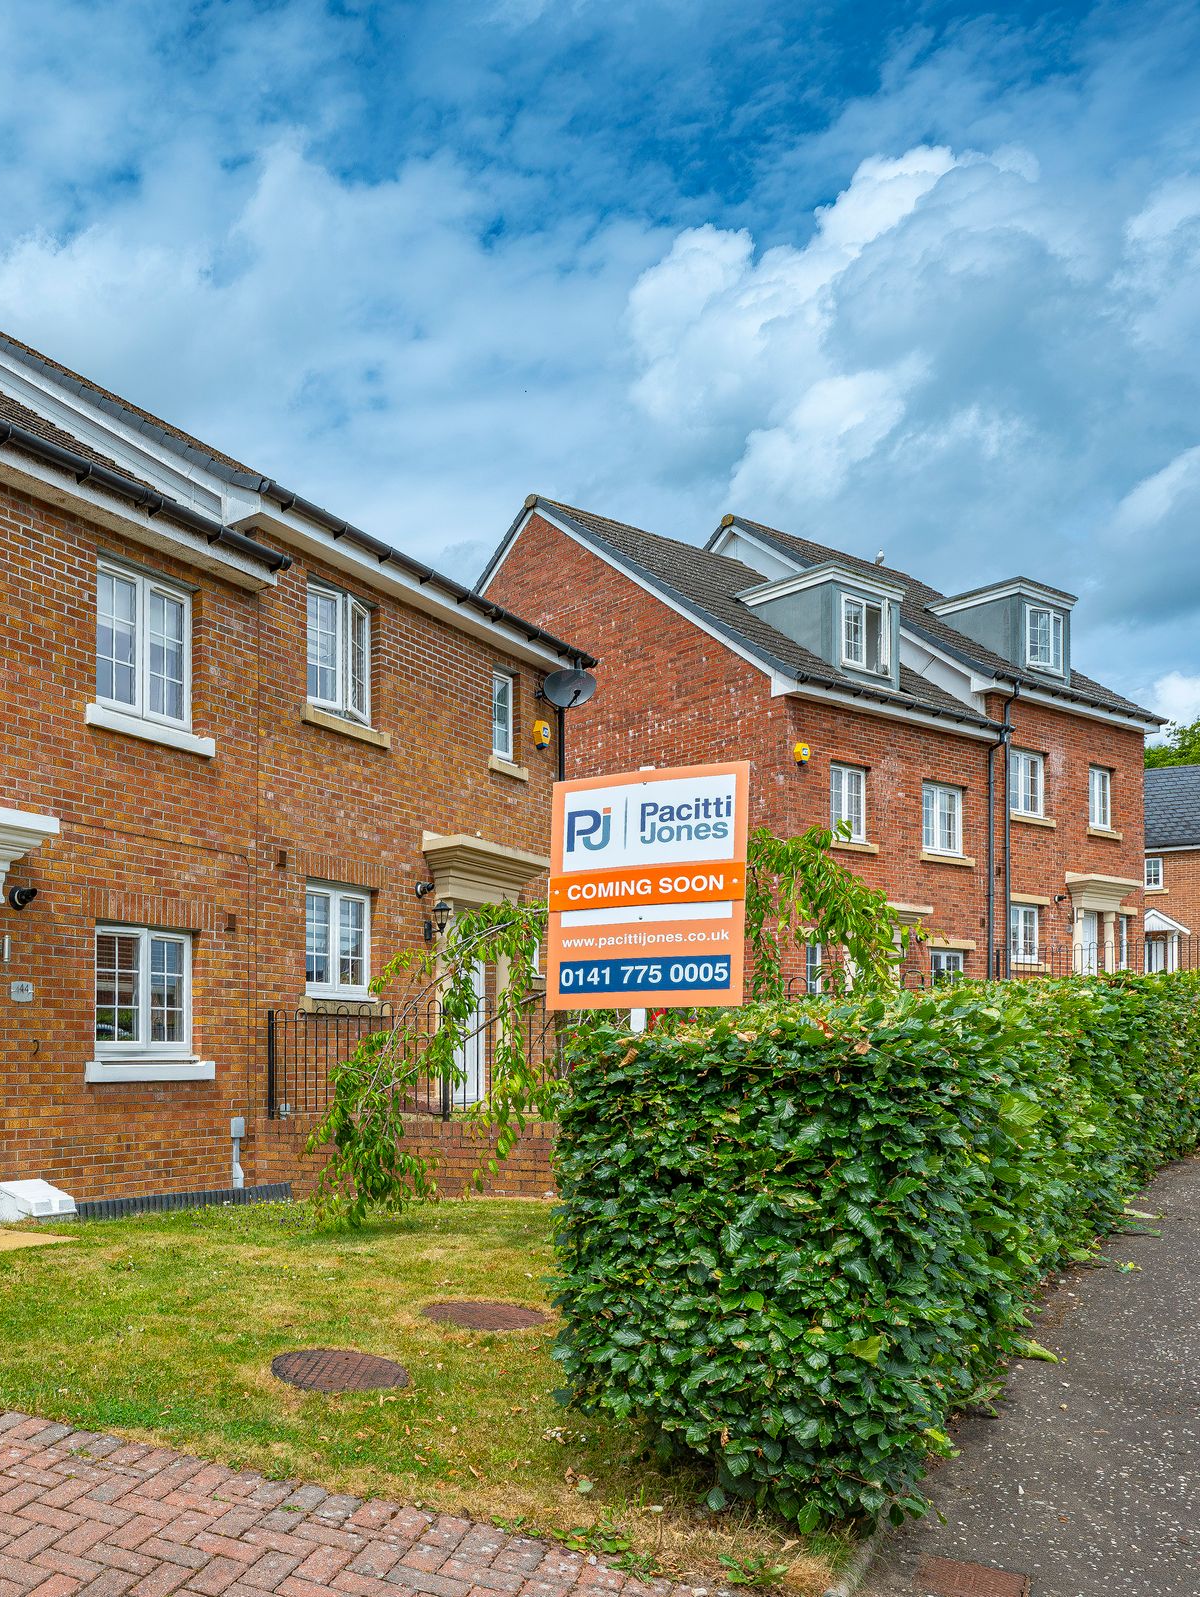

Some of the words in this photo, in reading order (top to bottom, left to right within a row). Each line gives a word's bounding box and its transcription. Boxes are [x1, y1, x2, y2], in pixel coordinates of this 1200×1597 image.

[640, 795, 732, 832] Pacitti
[640, 821, 728, 844] Jones
[567, 878, 652, 900] COMING
[658, 874, 725, 894] SOON
[562, 929, 729, 948] www.pacittijones.co.uk
[561, 966, 611, 987] 0141
[620, 964, 662, 984] 775
[669, 962, 728, 983] 0005
